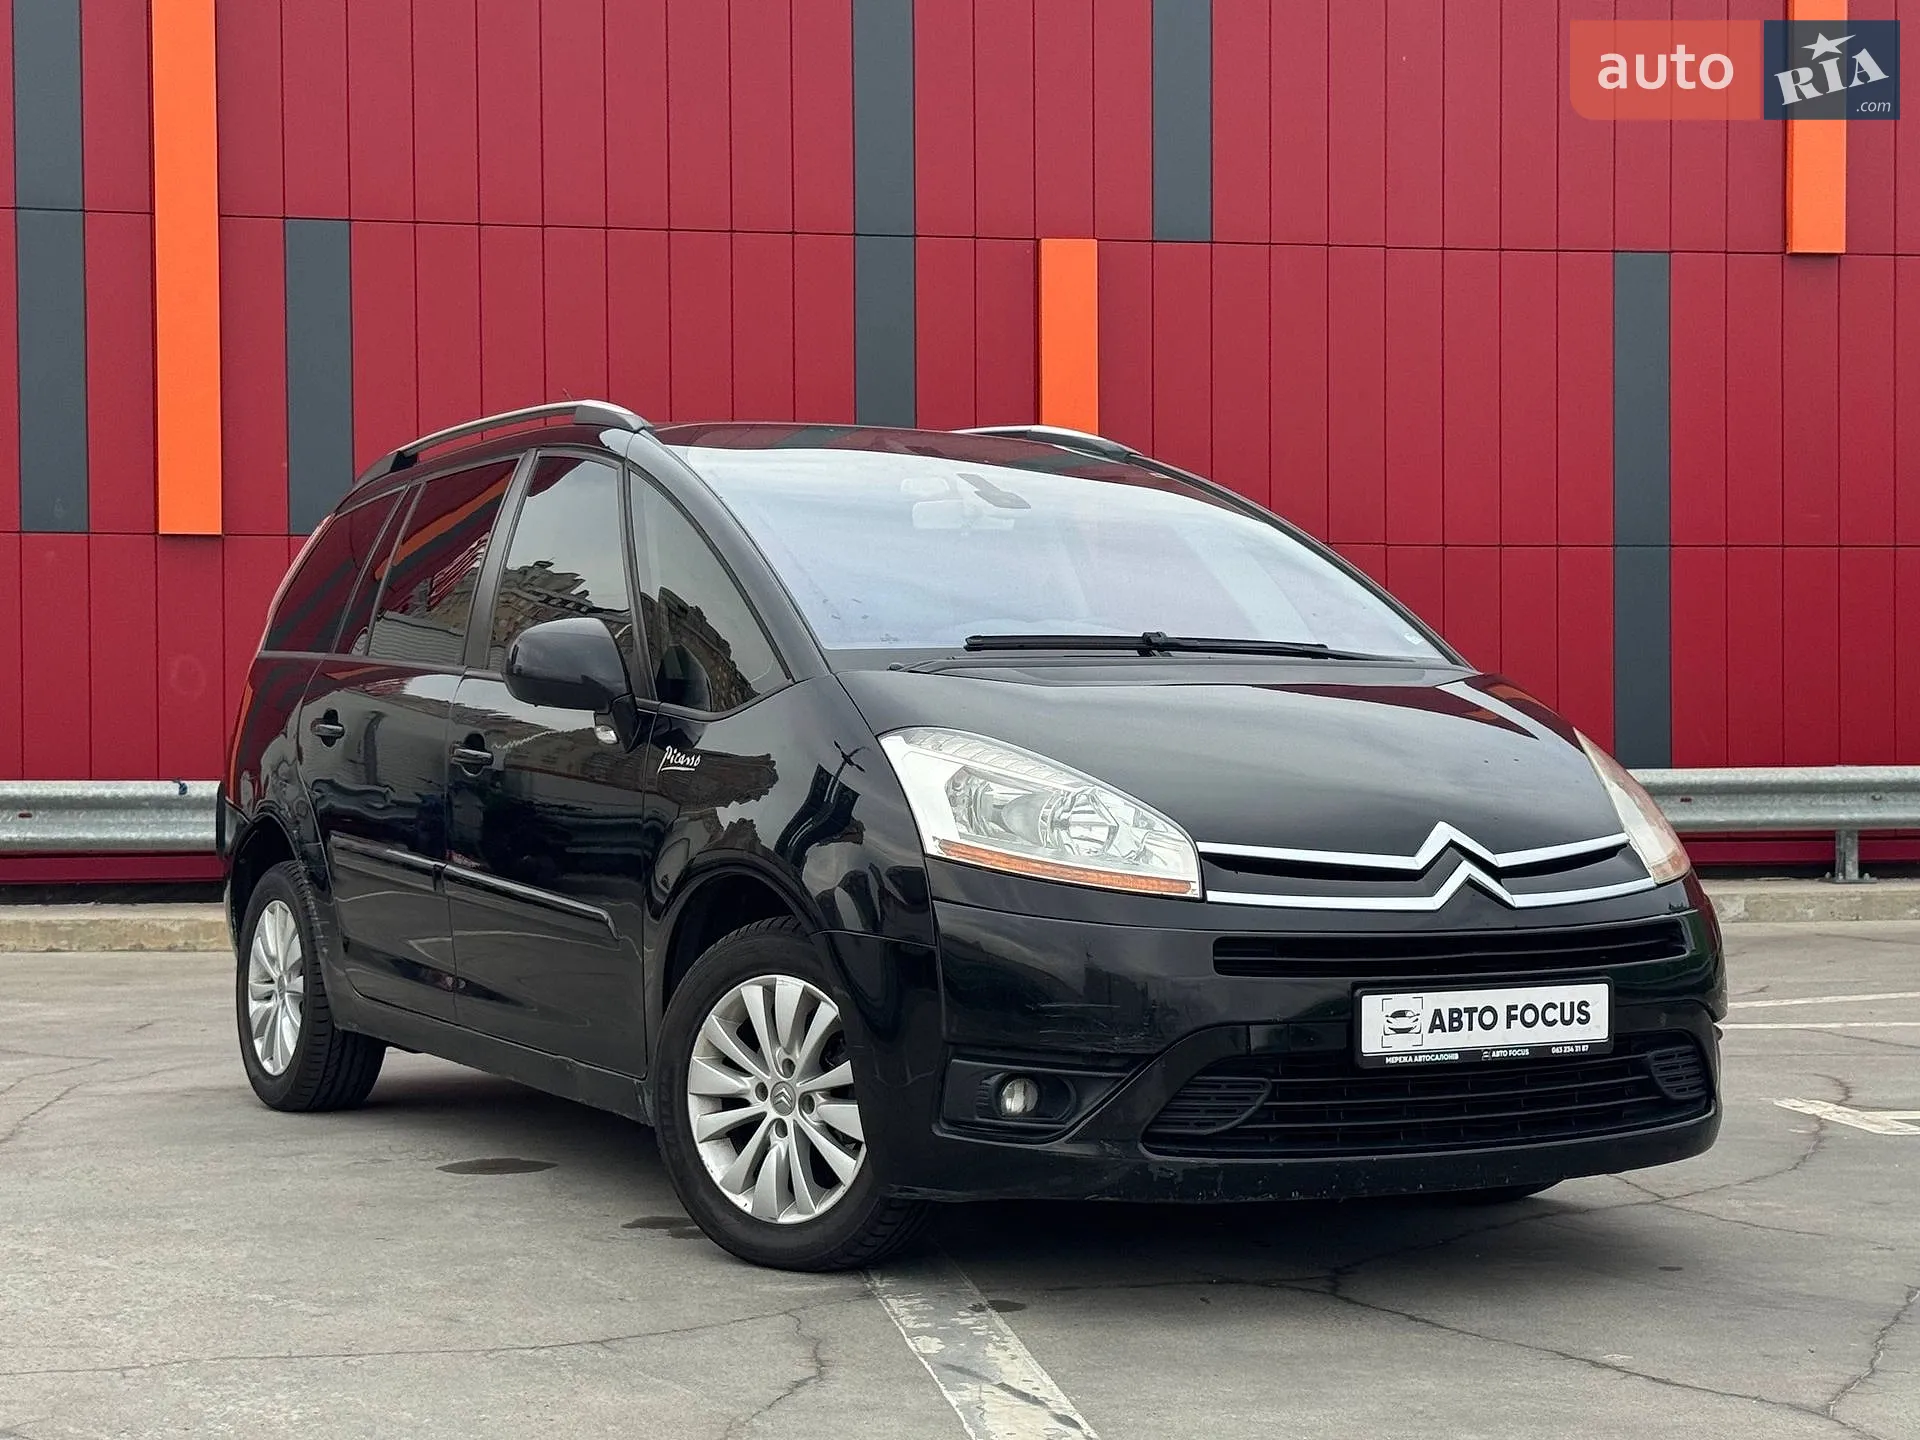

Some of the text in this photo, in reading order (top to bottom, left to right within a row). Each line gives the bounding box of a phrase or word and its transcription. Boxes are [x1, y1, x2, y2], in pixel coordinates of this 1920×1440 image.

[657, 745, 702, 774] Picasso
[1428, 1000, 1591, 1034] АВТО FOCUS
[1509, 1048, 1530, 1057] FOCUS
